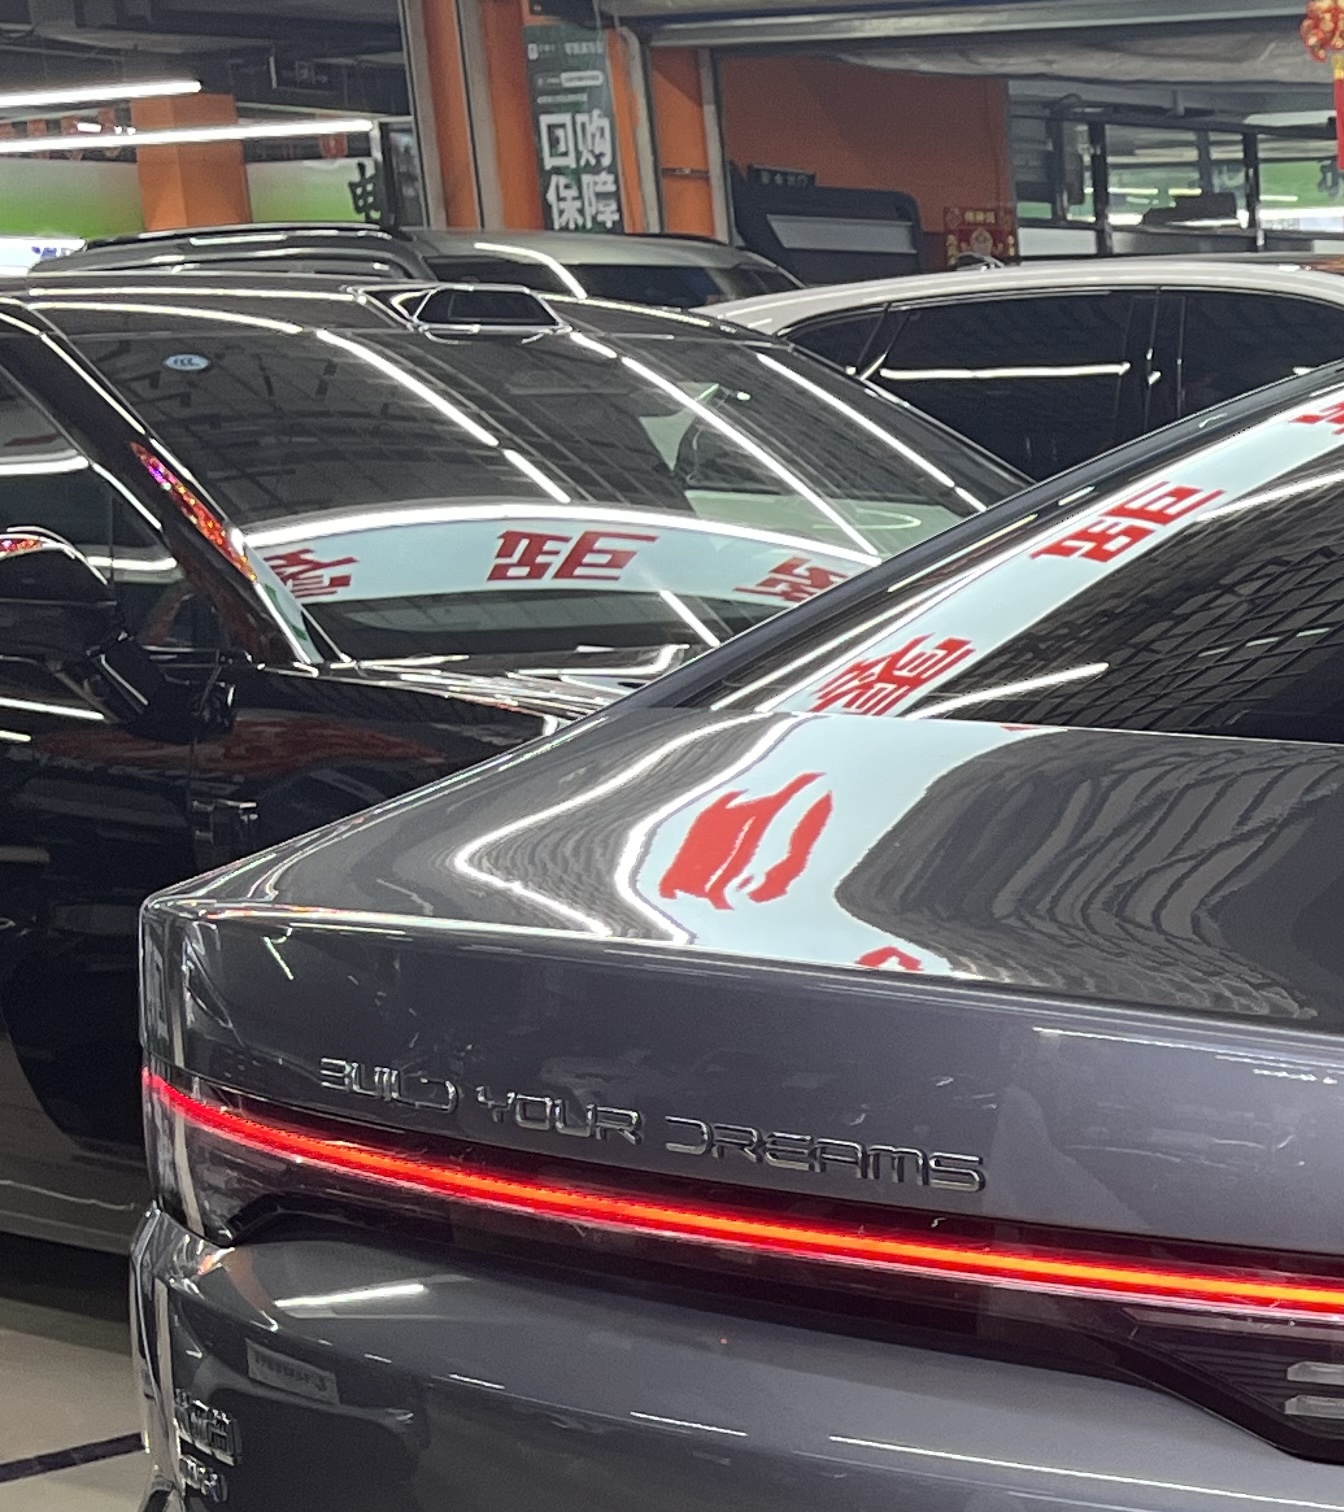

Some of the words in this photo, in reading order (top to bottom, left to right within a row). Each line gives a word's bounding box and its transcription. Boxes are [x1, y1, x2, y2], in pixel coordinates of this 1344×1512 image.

[538, 108, 613, 170] 回购
[545, 170, 620, 230] 保障
[319, 1056, 457, 1113] BUILD
[476, 1084, 645, 1147] YOUR
[664, 1114, 988, 1194] DREAMS
